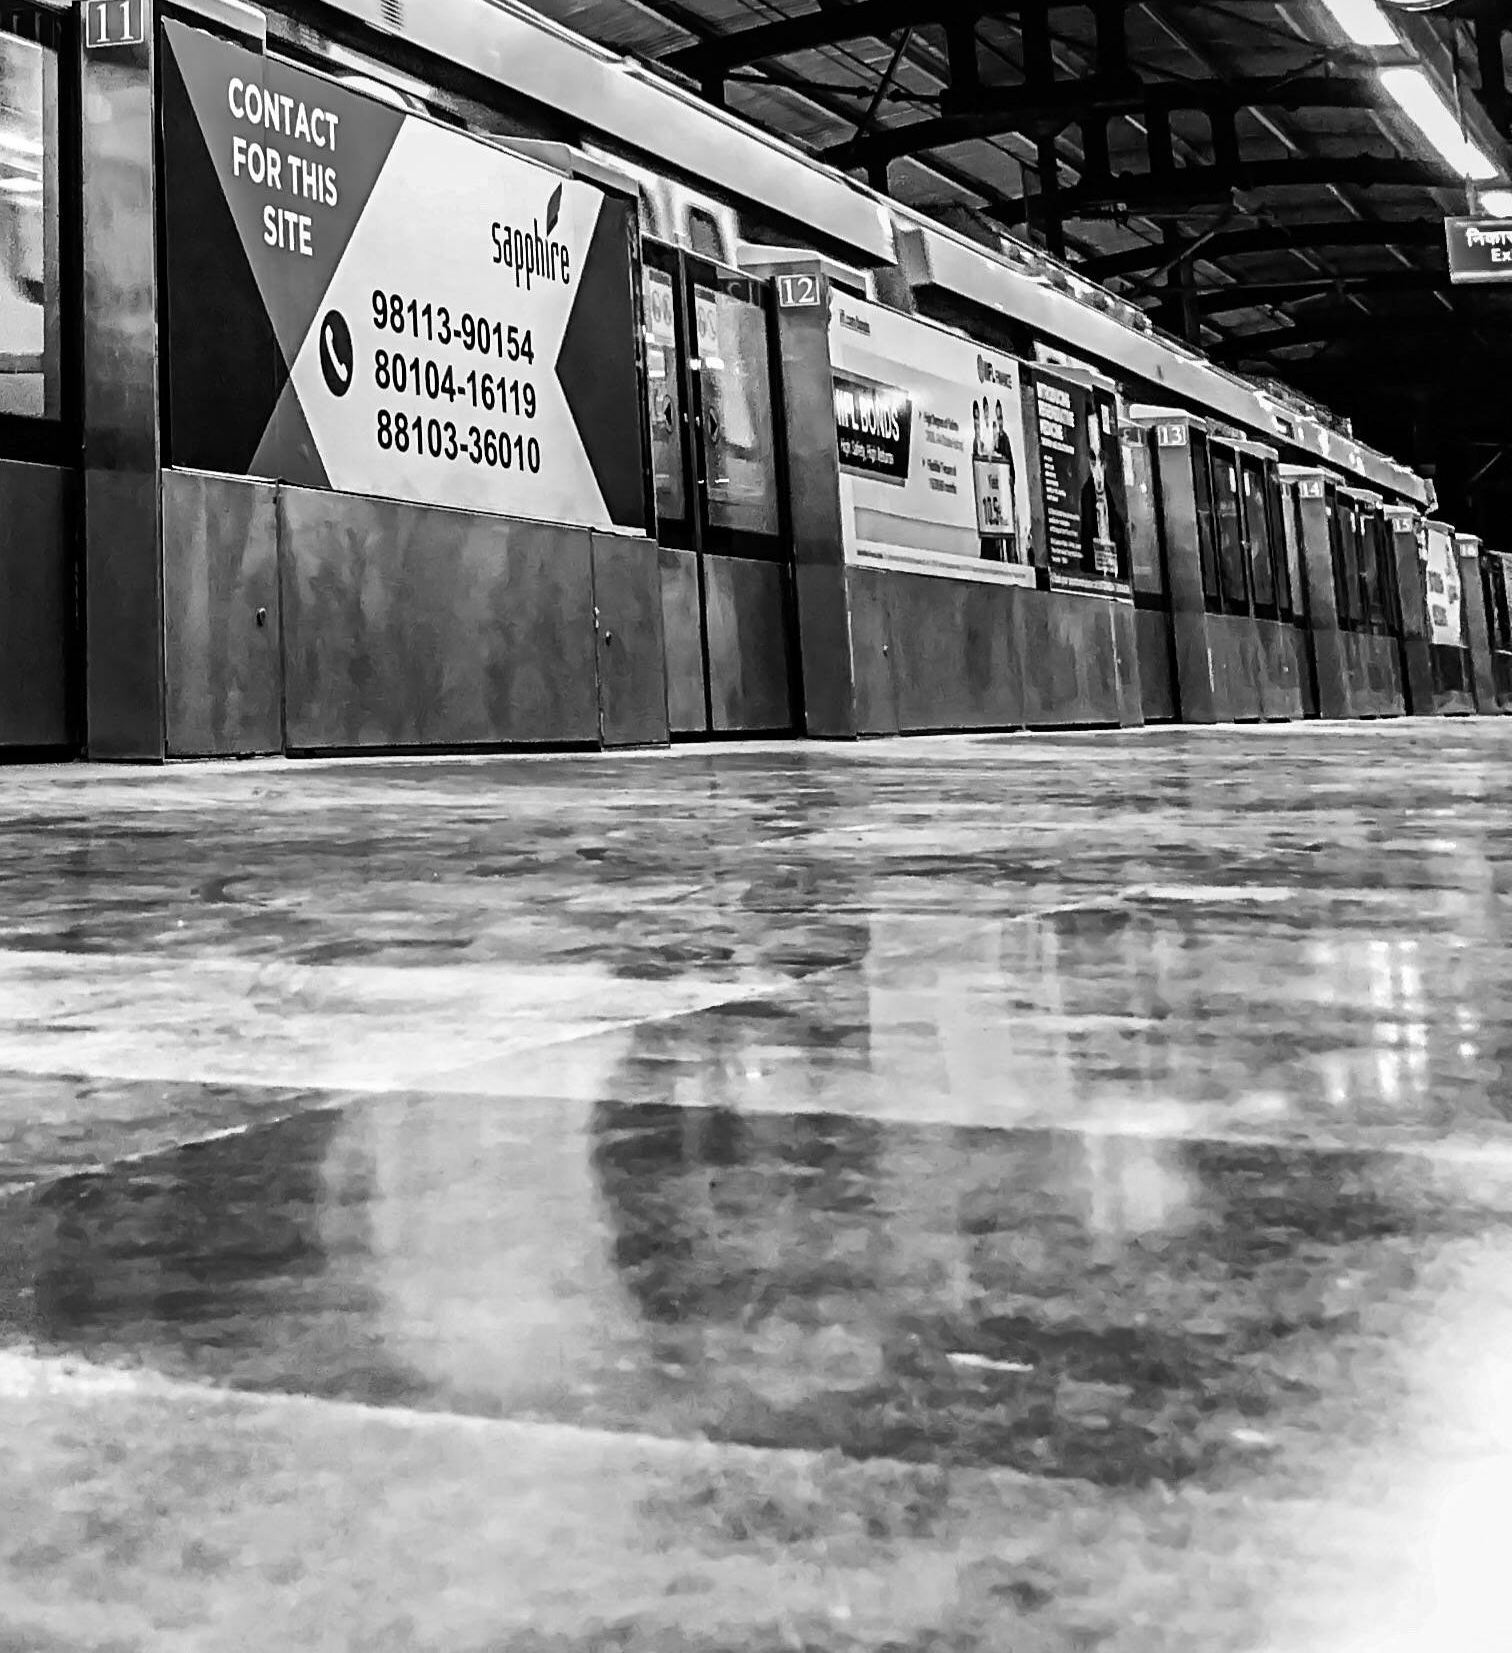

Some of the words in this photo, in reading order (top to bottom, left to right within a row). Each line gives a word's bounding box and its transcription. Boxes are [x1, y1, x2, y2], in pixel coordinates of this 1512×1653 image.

[95, 1, 133, 45] 11
[228, 77, 339, 152] CONTACT
[232, 136, 282, 190] FOR
[289, 154, 338, 208] THIS
[263, 205, 314, 257] SITE
[491, 220, 571, 291] sapphire
[780, 277, 816, 305] 12
[371, 290, 535, 366] 98113-90154
[374, 348, 537, 420] 80104-16119
[376, 408, 542, 474] 88103-36010
[860, 394, 900, 442] BONDS
[1160, 426, 1183, 444] 13
[1303, 482, 1321, 496] 14
